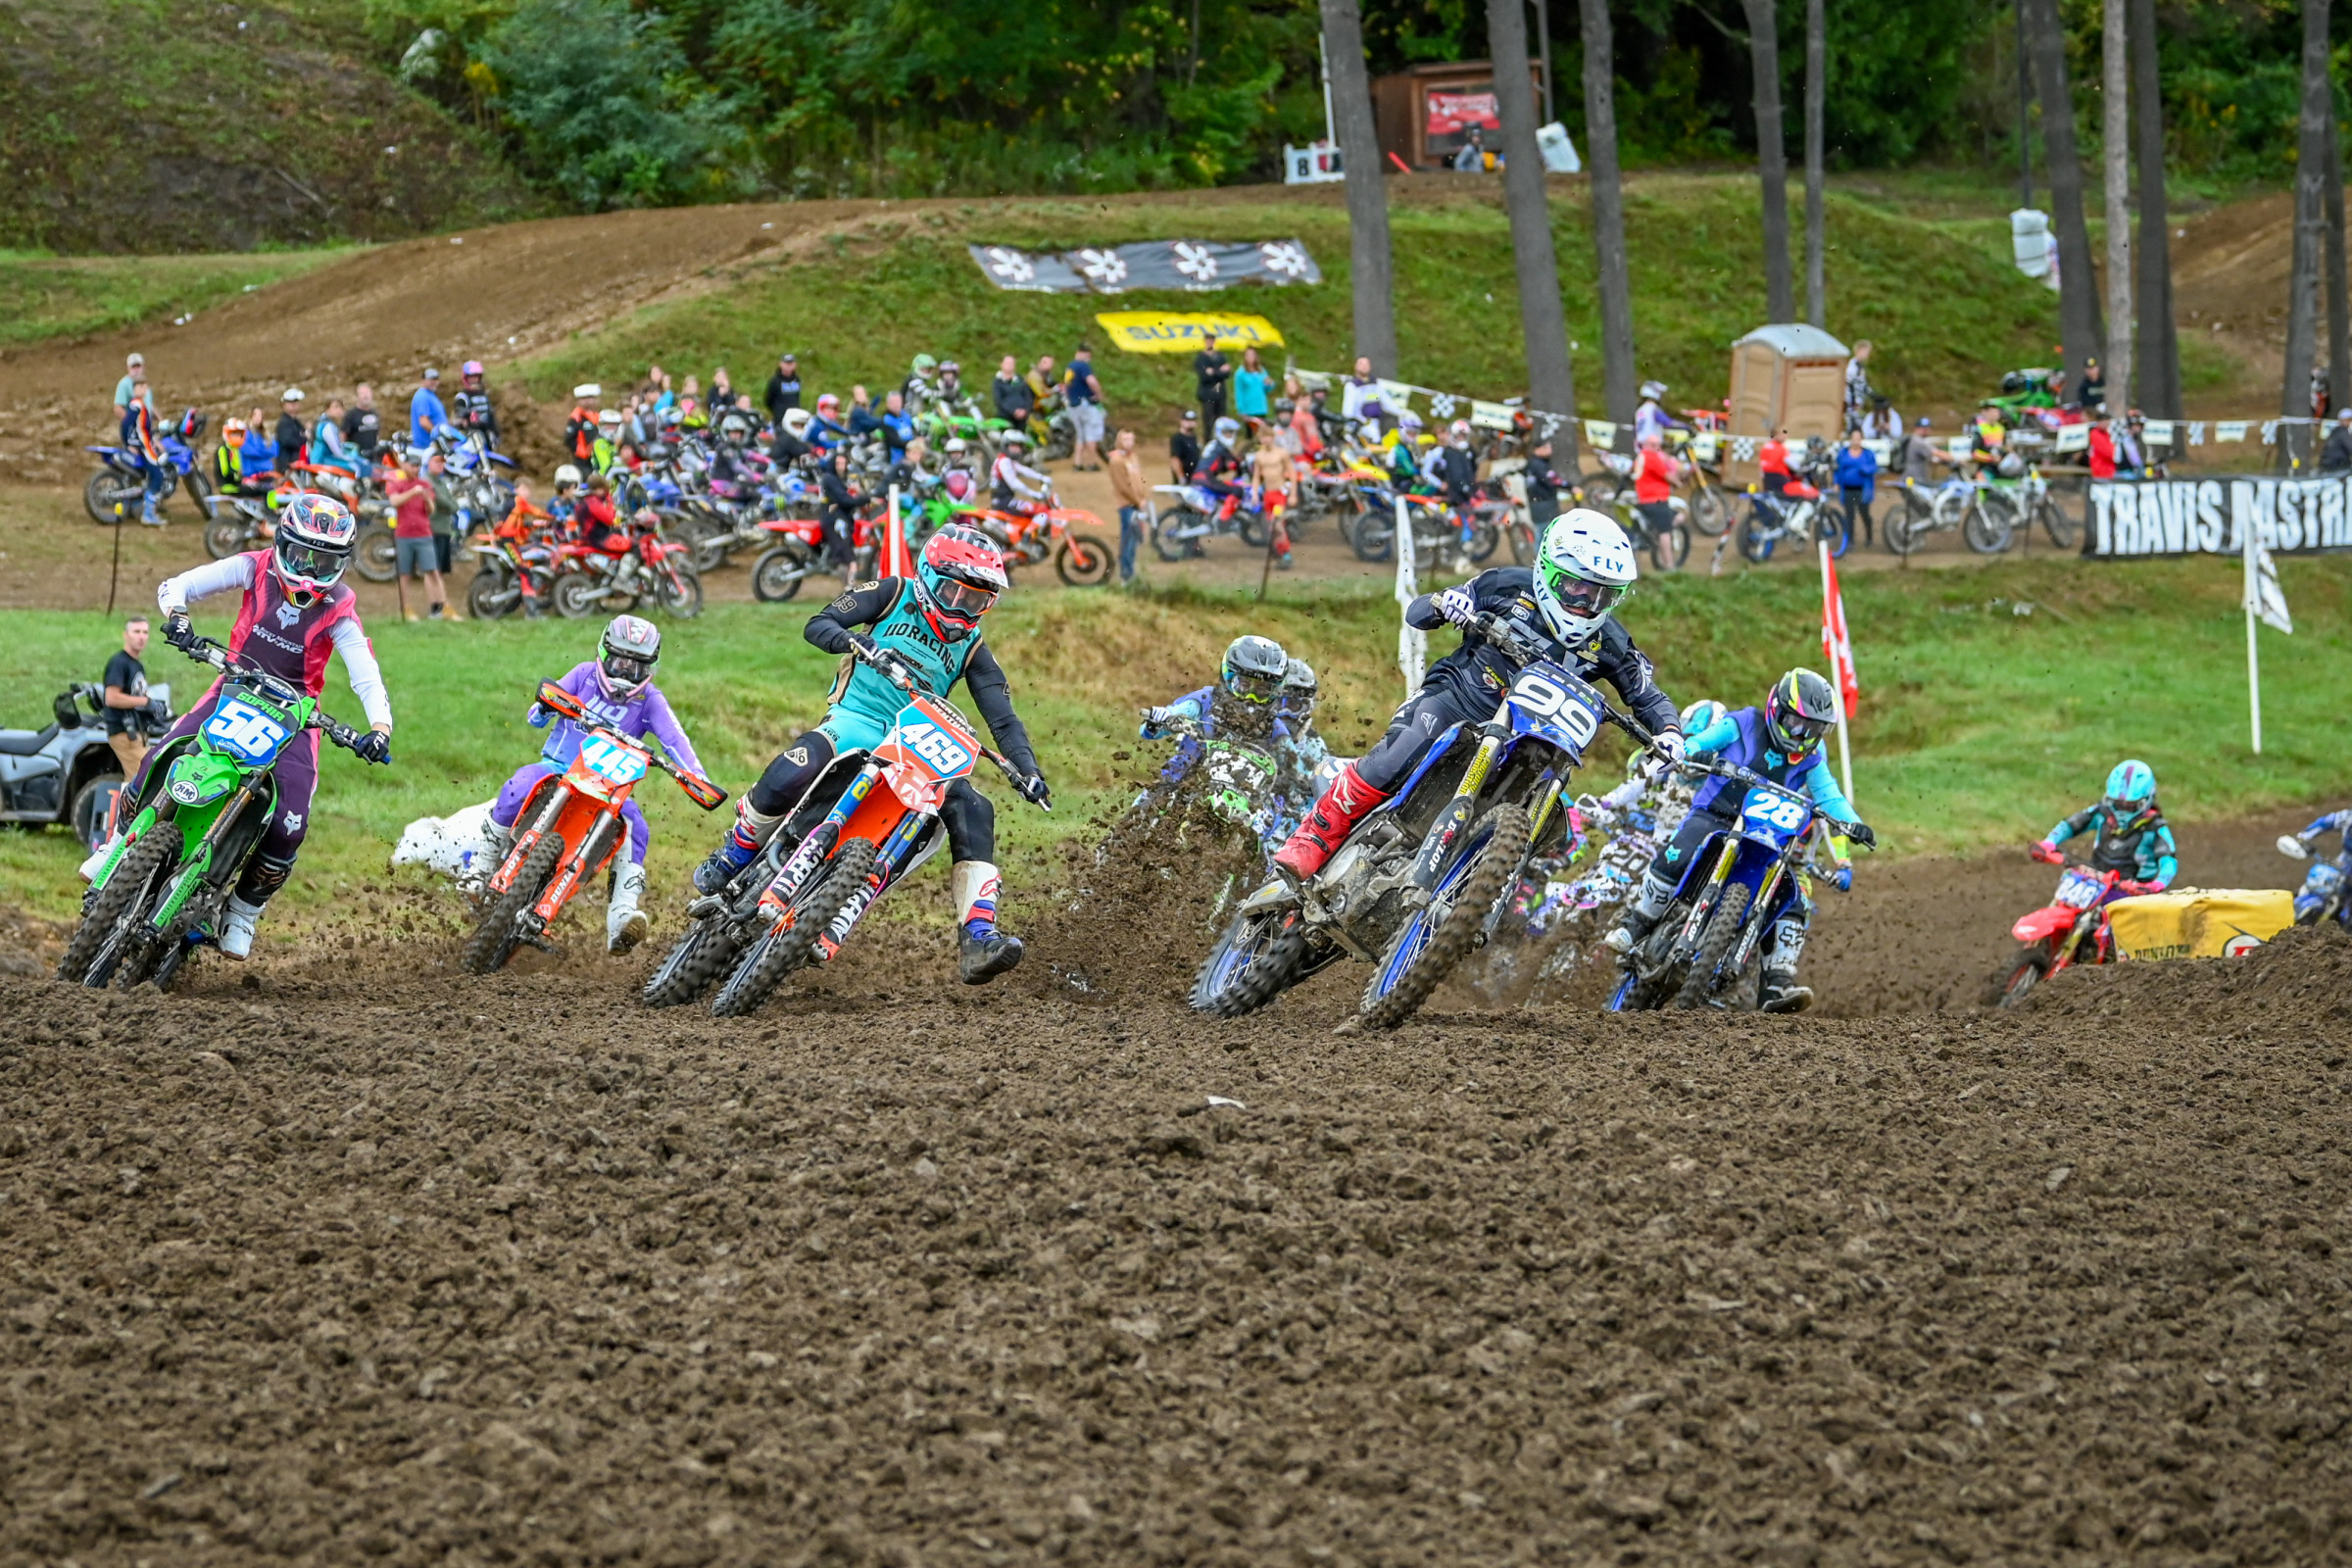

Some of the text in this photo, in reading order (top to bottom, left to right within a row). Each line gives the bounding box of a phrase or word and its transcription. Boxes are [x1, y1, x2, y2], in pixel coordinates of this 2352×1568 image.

[1127, 323, 1261, 341] SUZUKI
[2089, 479, 2224, 556] TRAVIS
[1593, 556, 1624, 573] FLY
[1537, 580, 1549, 602] FLY
[176, 618, 190, 634] FOX
[236, 691, 286, 722] SOPHIA
[1507, 674, 1597, 749] 99
[208, 700, 285, 758] 56
[900, 722, 969, 774] 469
[581, 741, 643, 785] 445
[1745, 792, 1804, 829] 28
[1429, 819, 1457, 873] DNLOP
[1734, 920, 1755, 963] DUNLOP
